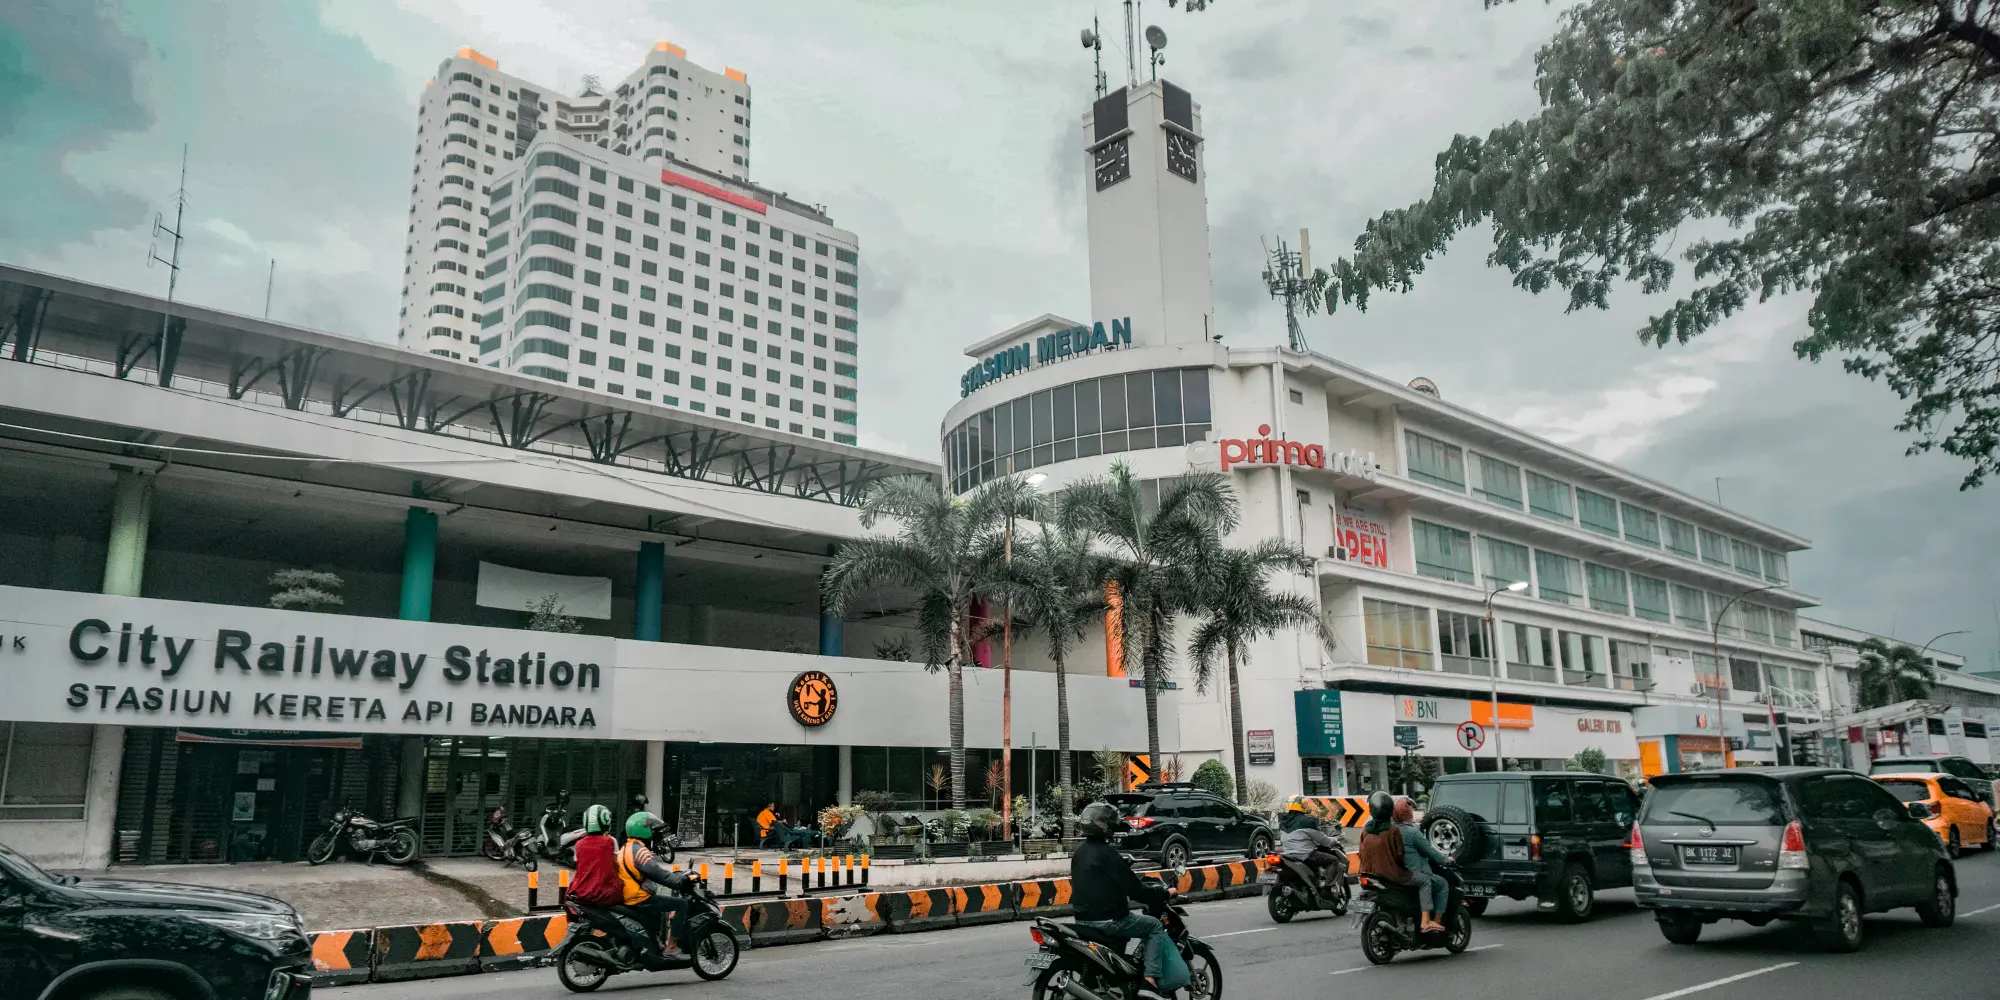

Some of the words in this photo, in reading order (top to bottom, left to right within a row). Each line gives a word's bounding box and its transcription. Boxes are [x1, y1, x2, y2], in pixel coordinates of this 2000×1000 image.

[960, 342, 1030, 398] STASIUN
[1037, 317, 1131, 363] MEDAN
[1343, 516, 1353, 527] WE
[1356, 519, 1368, 531] ARE
[1370, 522, 1386, 535] STILL
[0, 635, 26, 649] K
[69, 618, 195, 676] City
[214, 629, 427, 689] Railway
[442, 645, 600, 688] Station
[66, 682, 231, 714] STASIUN
[254, 692, 386, 720] KERETA
[402, 700, 453, 722] API
[470, 702, 596, 727] BANDARA
[1417, 700, 1438, 719] BNI
[1577, 718, 1605, 733] GALERI
[1607, 719, 1622, 734] ATM
[1465, 727, 1477, 747] P
[1686, 847, 1696, 857] BK
[1700, 847, 1718, 858] 1172
[1722, 848, 1733, 858] JZ
